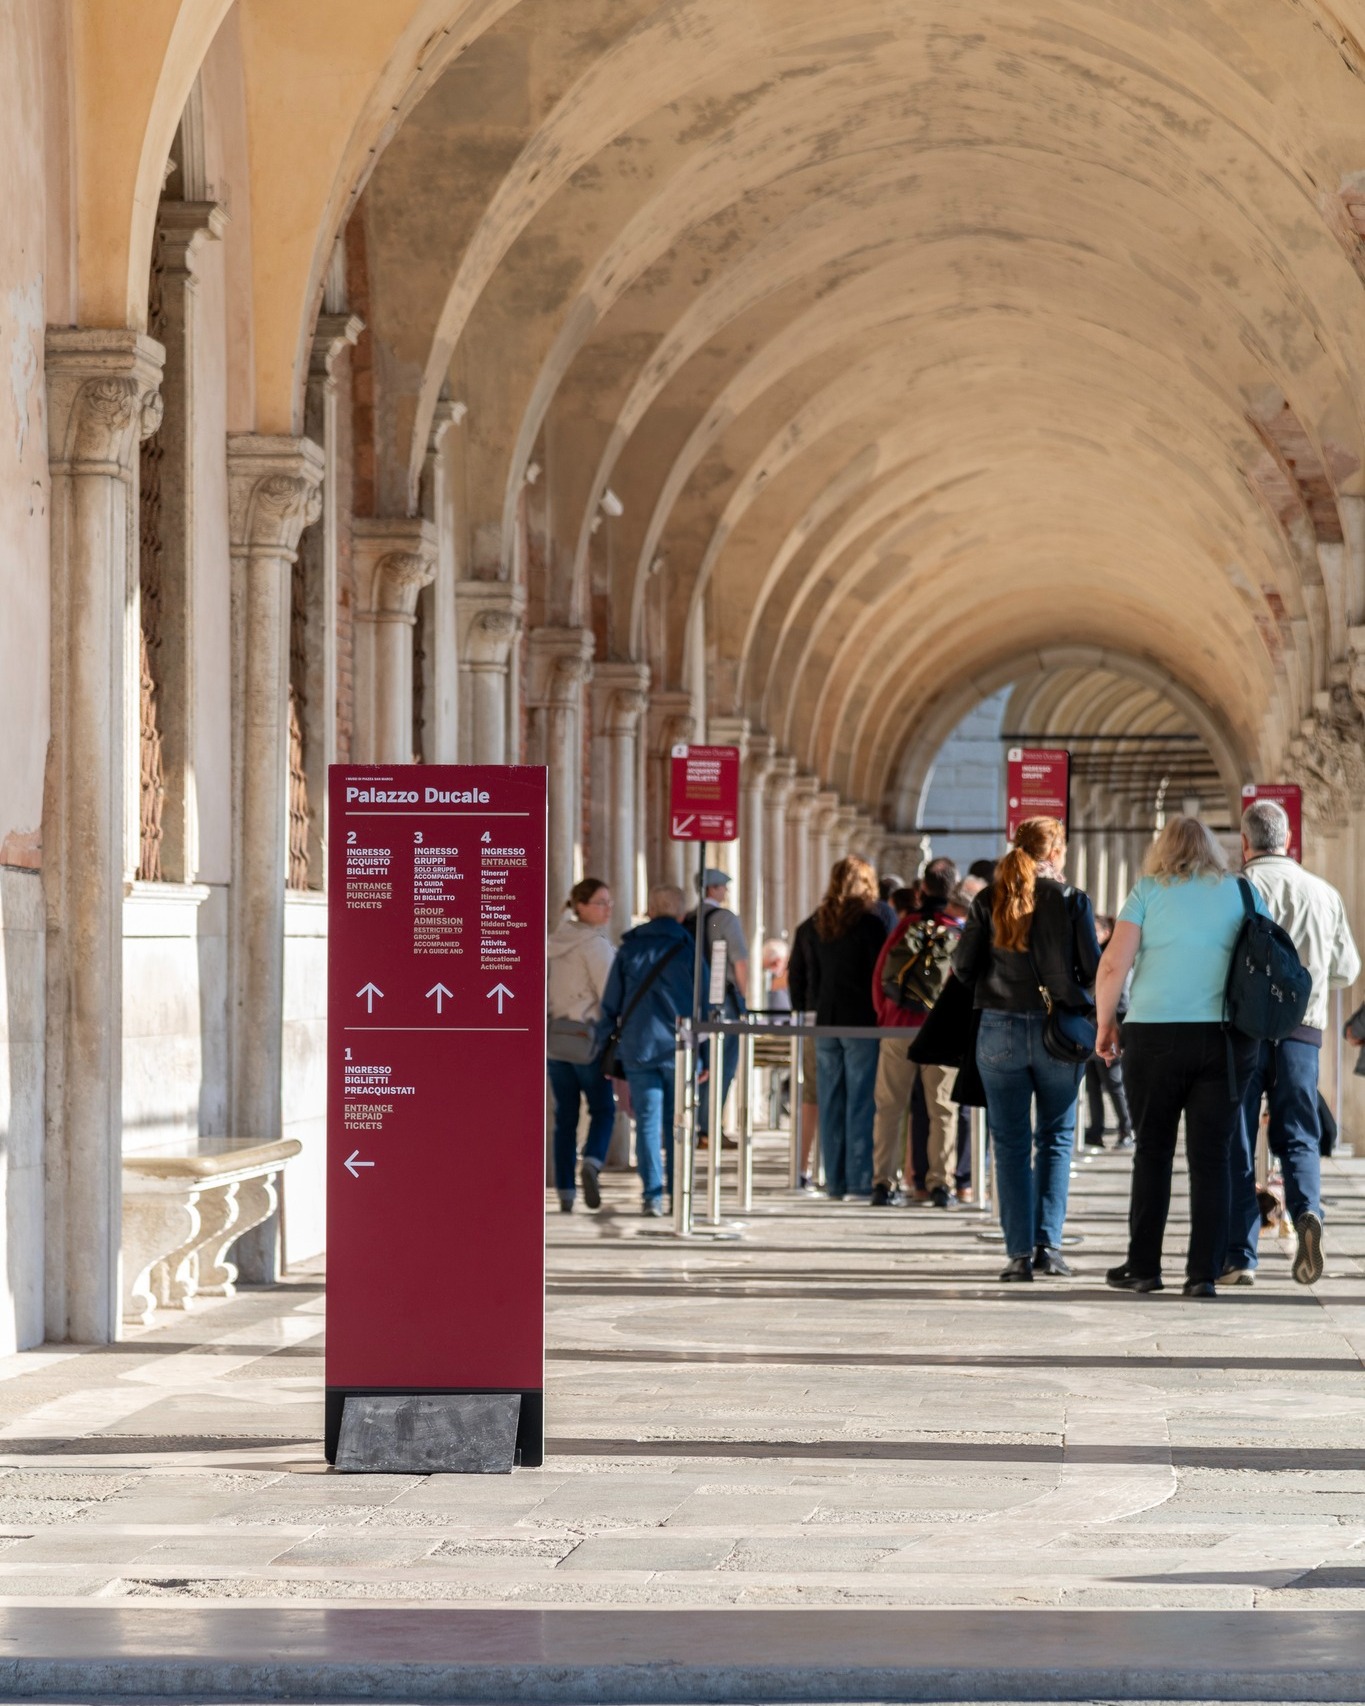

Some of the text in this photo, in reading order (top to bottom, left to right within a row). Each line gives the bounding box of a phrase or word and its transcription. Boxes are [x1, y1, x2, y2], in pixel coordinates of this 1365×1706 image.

[346, 787, 490, 803] Palazzo Ducale
[347, 831, 356, 844] 2
[414, 832, 423, 844] 3
[481, 831, 491, 843] 4
[347, 858, 390, 867] ACQUISTO
[344, 1048, 352, 1060] 1
[345, 1066, 392, 1074] INGRESSO
[344, 1087, 415, 1096] PREACQUISTATI
[344, 1104, 393, 1112] ENTRANCE
